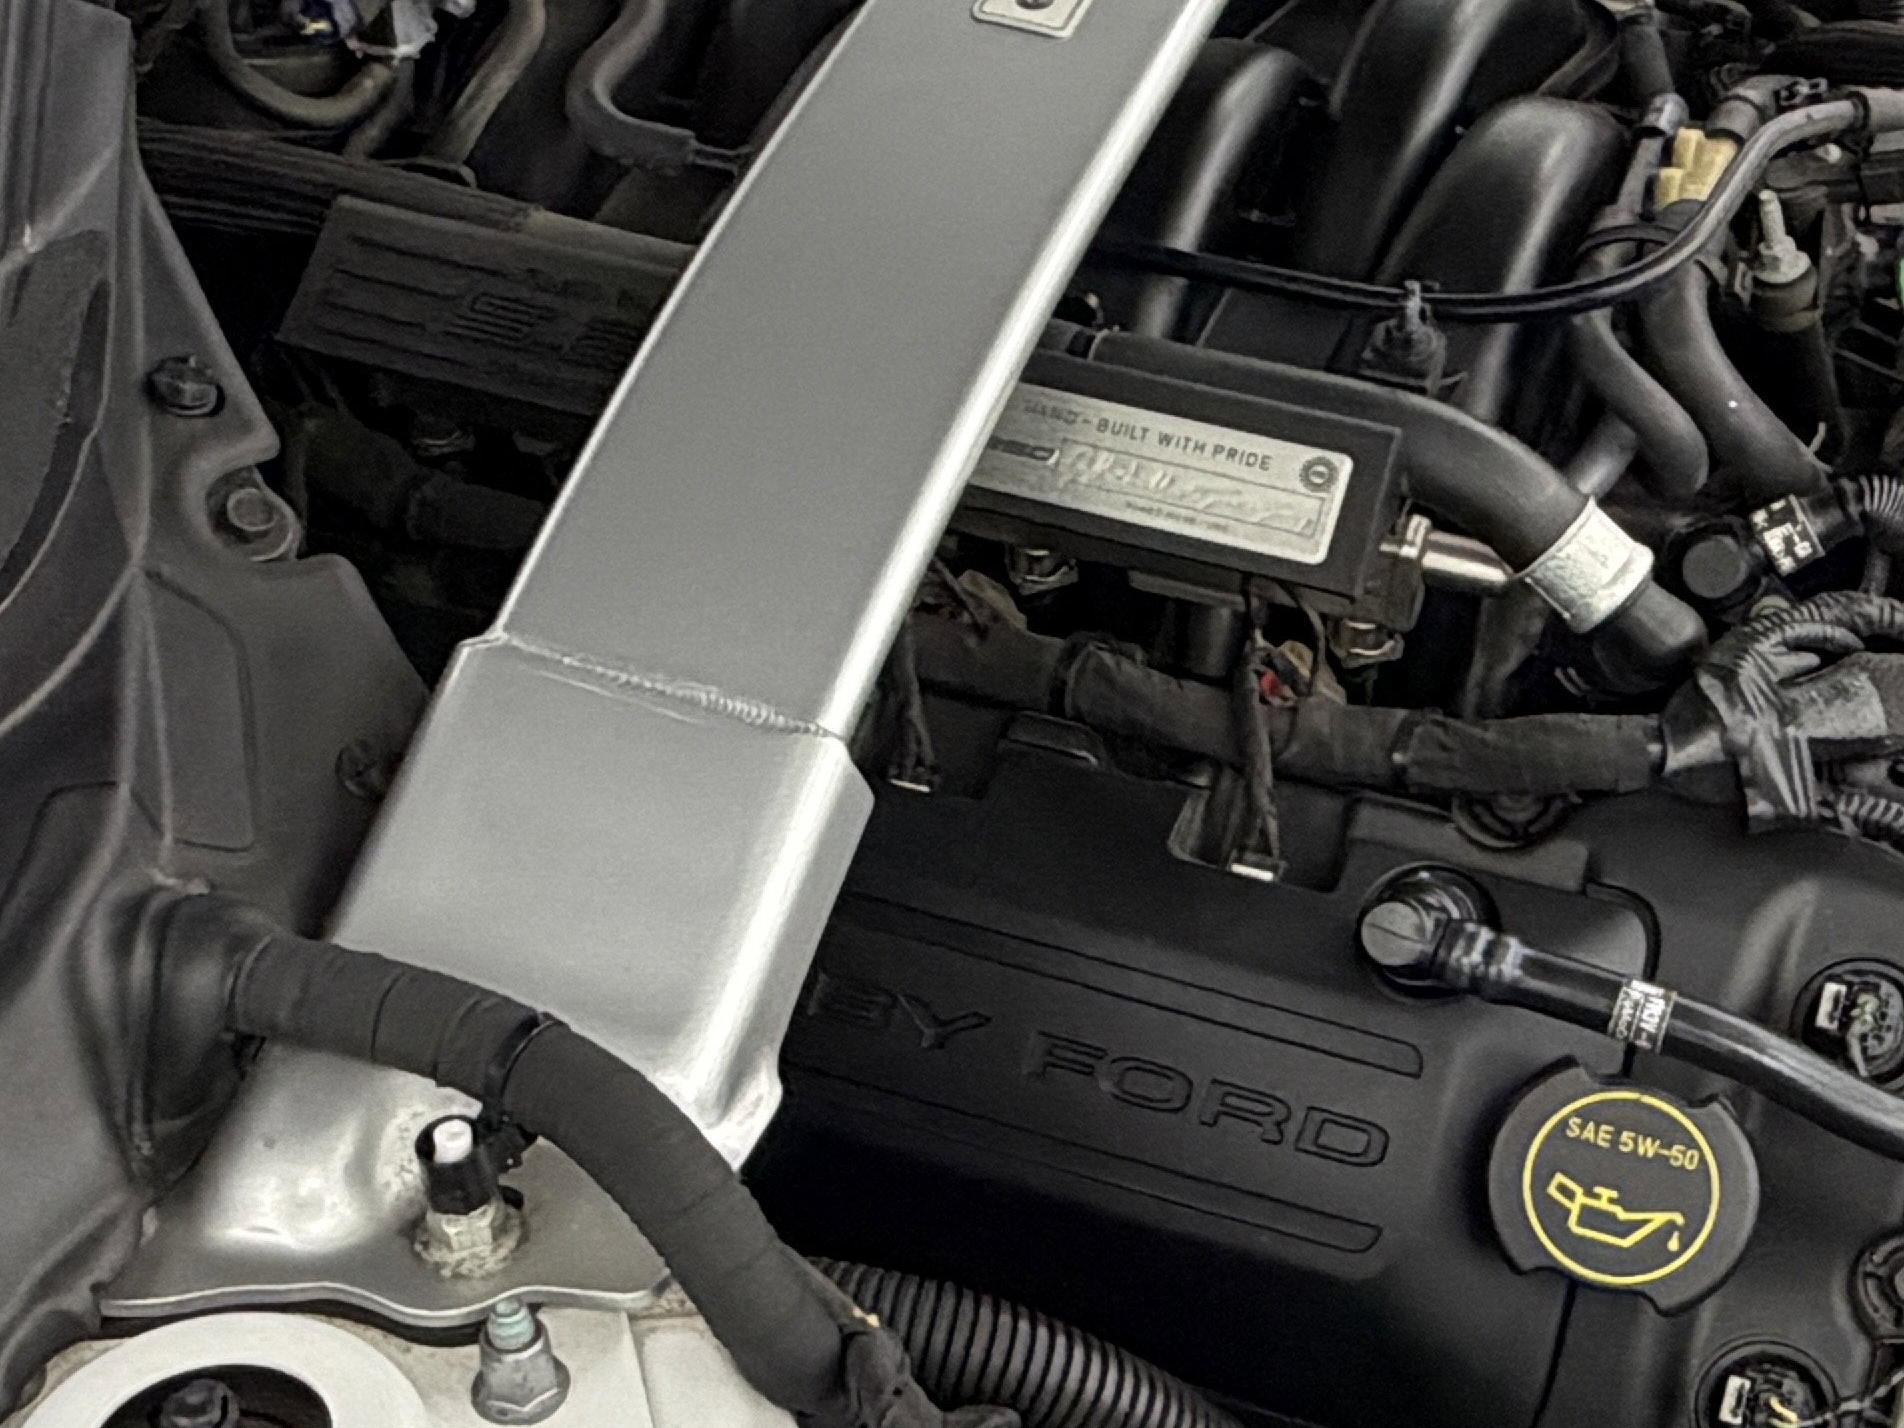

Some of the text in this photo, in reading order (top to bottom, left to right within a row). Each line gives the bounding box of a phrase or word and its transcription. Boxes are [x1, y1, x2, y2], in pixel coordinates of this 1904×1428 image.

[1157, 430, 1208, 455] WITH
[1212, 443, 1274, 472] PRIDE
[1024, 1028, 1391, 1169] FORD
[1565, 1116, 1701, 1172] SAE 5W-50
